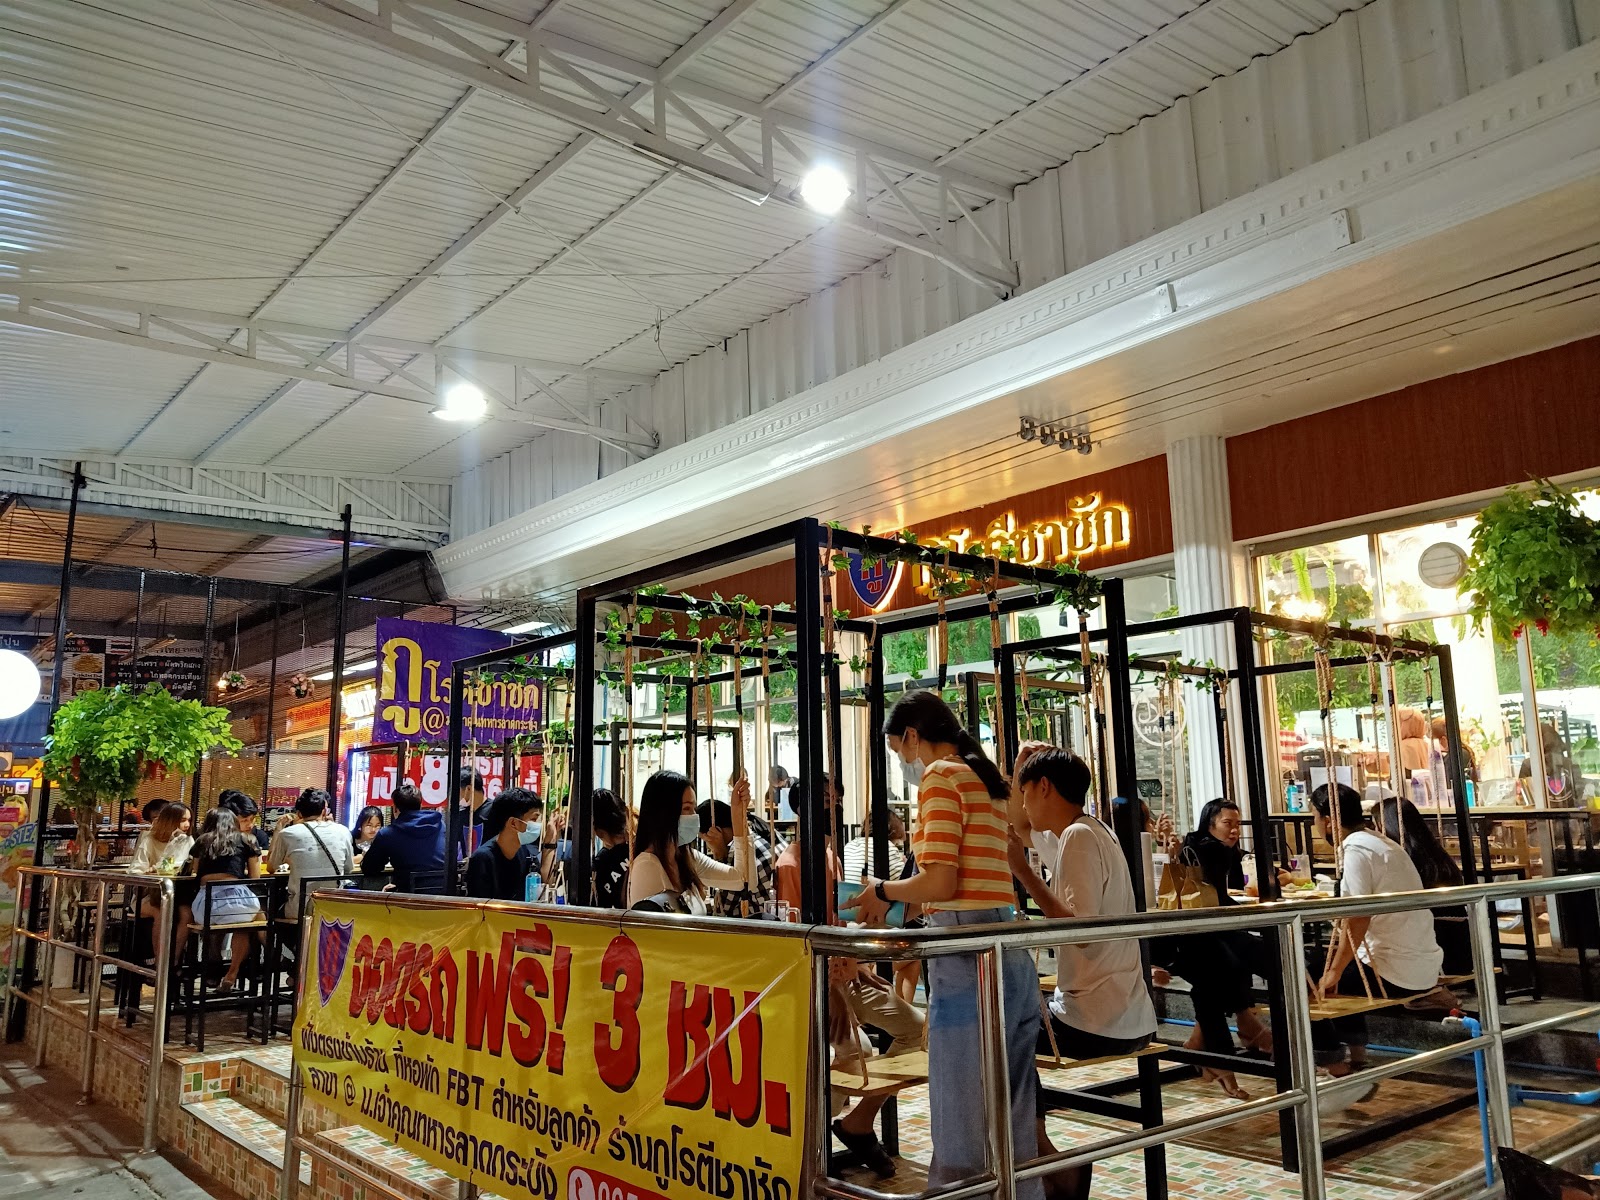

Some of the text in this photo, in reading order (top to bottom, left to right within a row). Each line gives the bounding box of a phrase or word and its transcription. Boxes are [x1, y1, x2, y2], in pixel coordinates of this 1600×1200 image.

[348, 934, 459, 1044] จอดรถ
[594, 935, 644, 1093] 3
[662, 980, 792, 1137] ชม.
[343, 1075, 357, 1107] @
[446, 1067, 486, 1111] FBT
